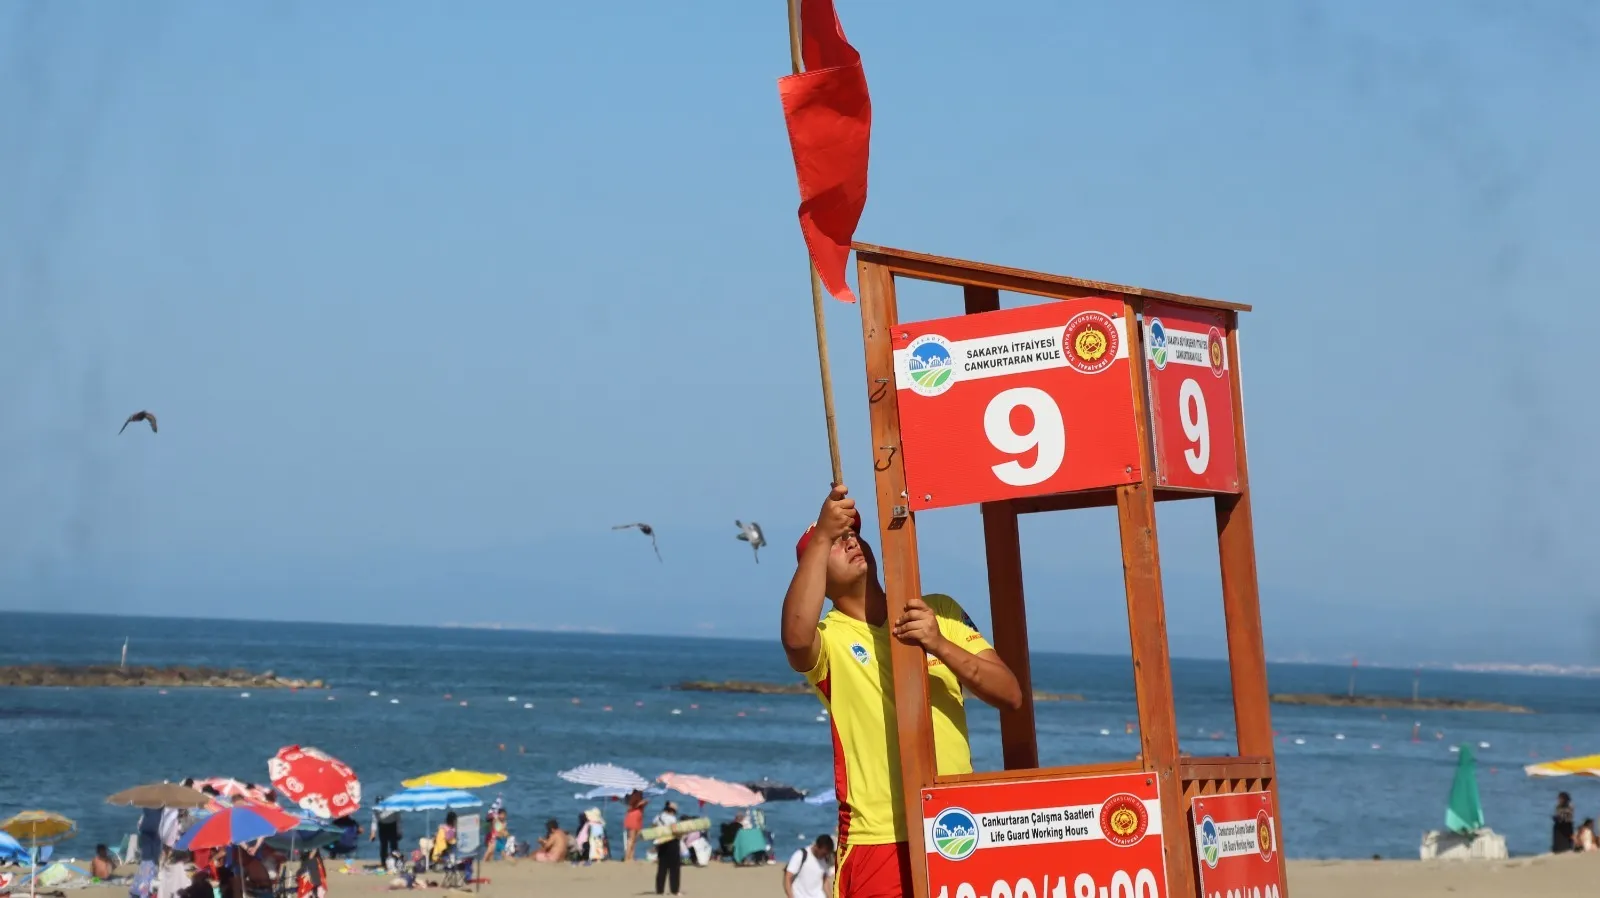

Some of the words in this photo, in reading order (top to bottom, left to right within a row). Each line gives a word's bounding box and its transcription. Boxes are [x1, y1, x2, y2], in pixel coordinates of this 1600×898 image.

[966, 345, 1009, 359] SAKARYA
[1011, 336, 1055, 352] İTFAİYESİ
[964, 354, 1033, 372] CANKURTARAN
[1035, 350, 1060, 361] KULE
[983, 387, 1066, 486] 9
[1179, 378, 1211, 474] 9
[982, 815, 1030, 827] Cankurtaran
[1031, 812, 1062, 826] Çalışma
[1064, 808, 1095, 821] Saatleri
[990, 831, 1005, 842] Life
[1007, 829, 1030, 841] Guard
[1032, 827, 1063, 839] Working
[1065, 825, 1089, 836] Hours
